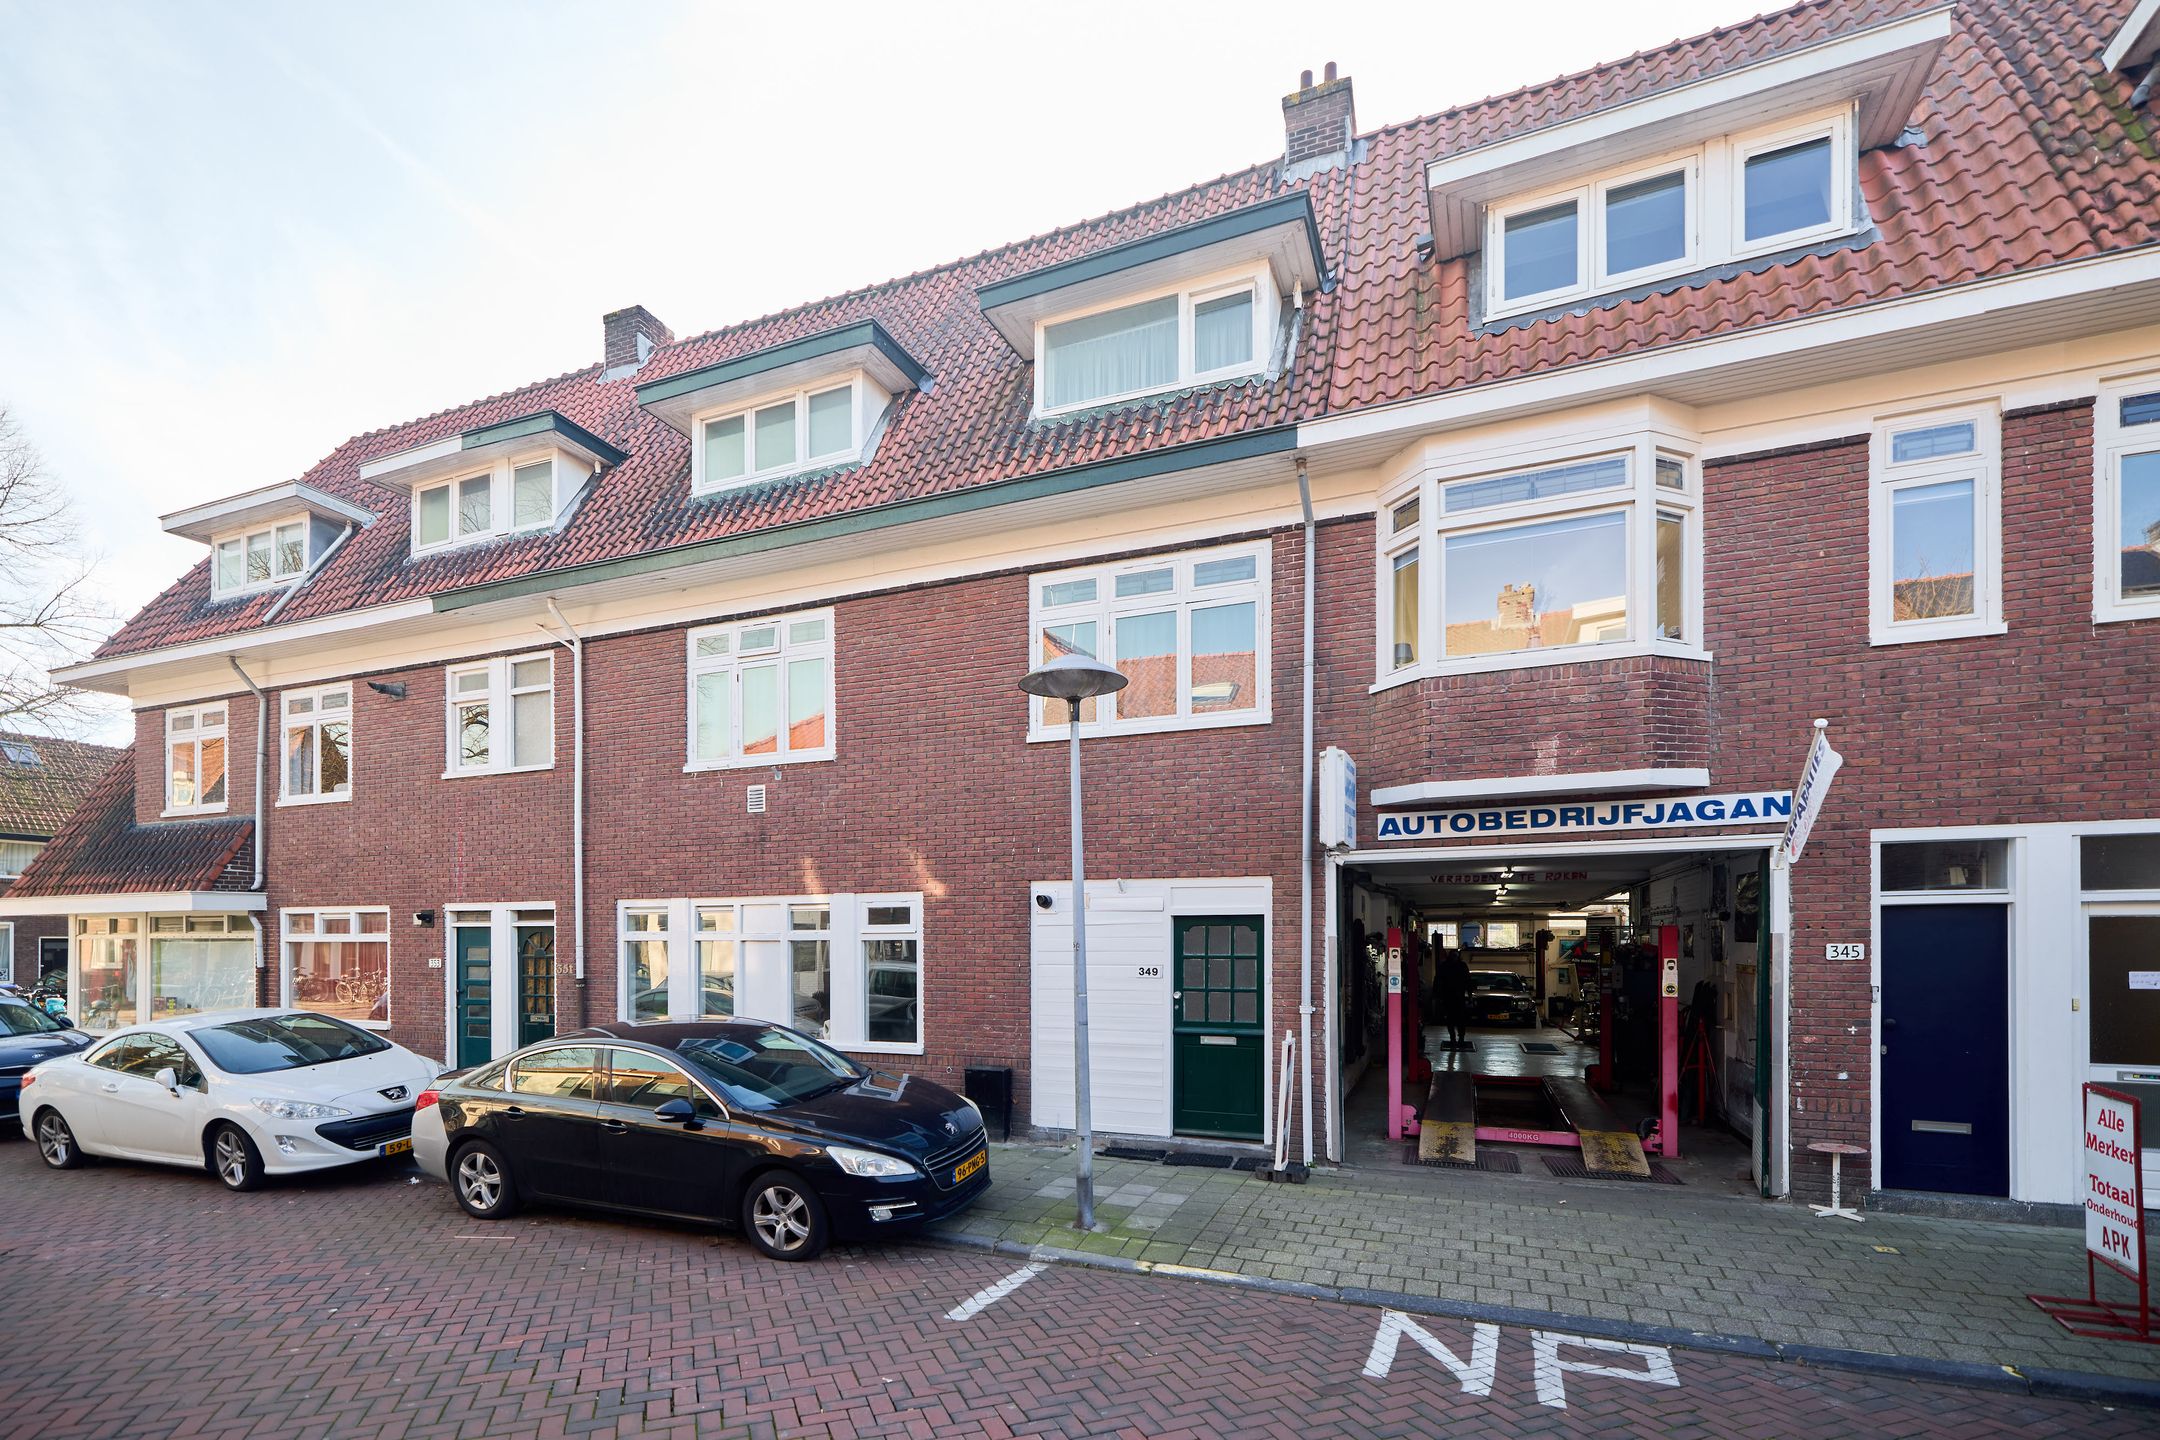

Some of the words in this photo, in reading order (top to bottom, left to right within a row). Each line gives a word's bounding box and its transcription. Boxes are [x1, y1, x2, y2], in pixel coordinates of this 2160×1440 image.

[1520, 873, 1535, 882] TE
[1830, 945, 1860, 958] 345
[430, 959, 440, 968] 353
[1138, 967, 1159, 976] 349
[2097, 1108, 2124, 1133] Alle
[1509, 1132, 1539, 1141] 4000KG
[2089, 1173, 2135, 1208] Totaal
[2102, 1226, 2131, 1260] APK
